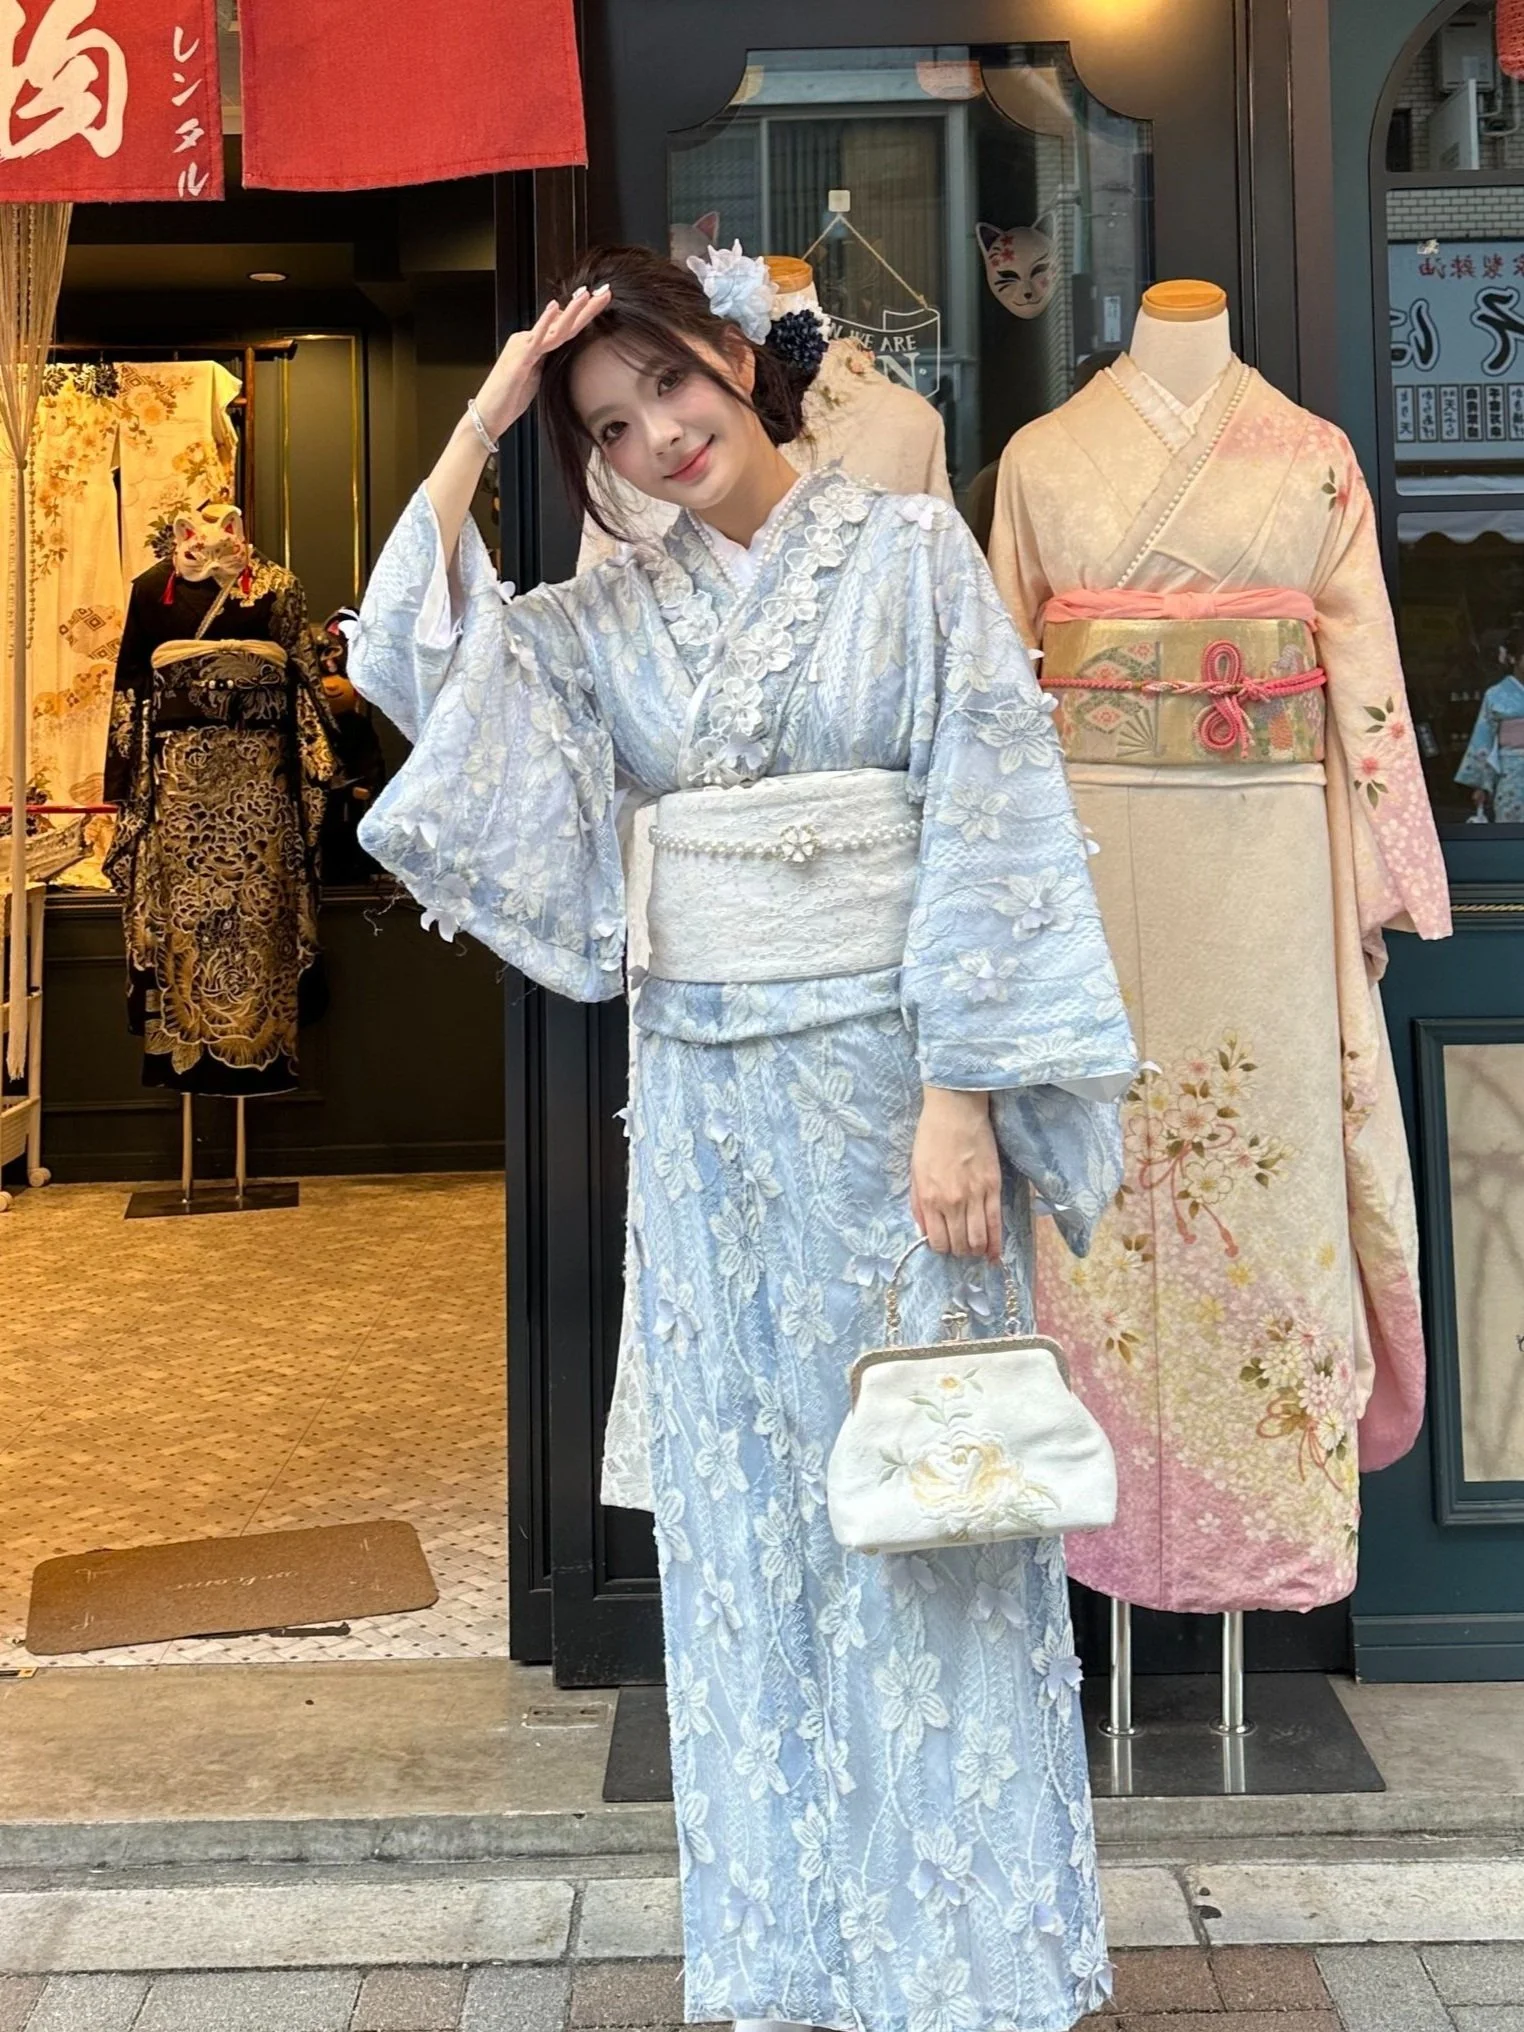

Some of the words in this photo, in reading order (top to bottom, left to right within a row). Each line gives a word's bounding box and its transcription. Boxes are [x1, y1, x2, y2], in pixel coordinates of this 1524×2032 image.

[171, 26, 209, 197] レンタル
[880, 334, 917, 353] ARE
